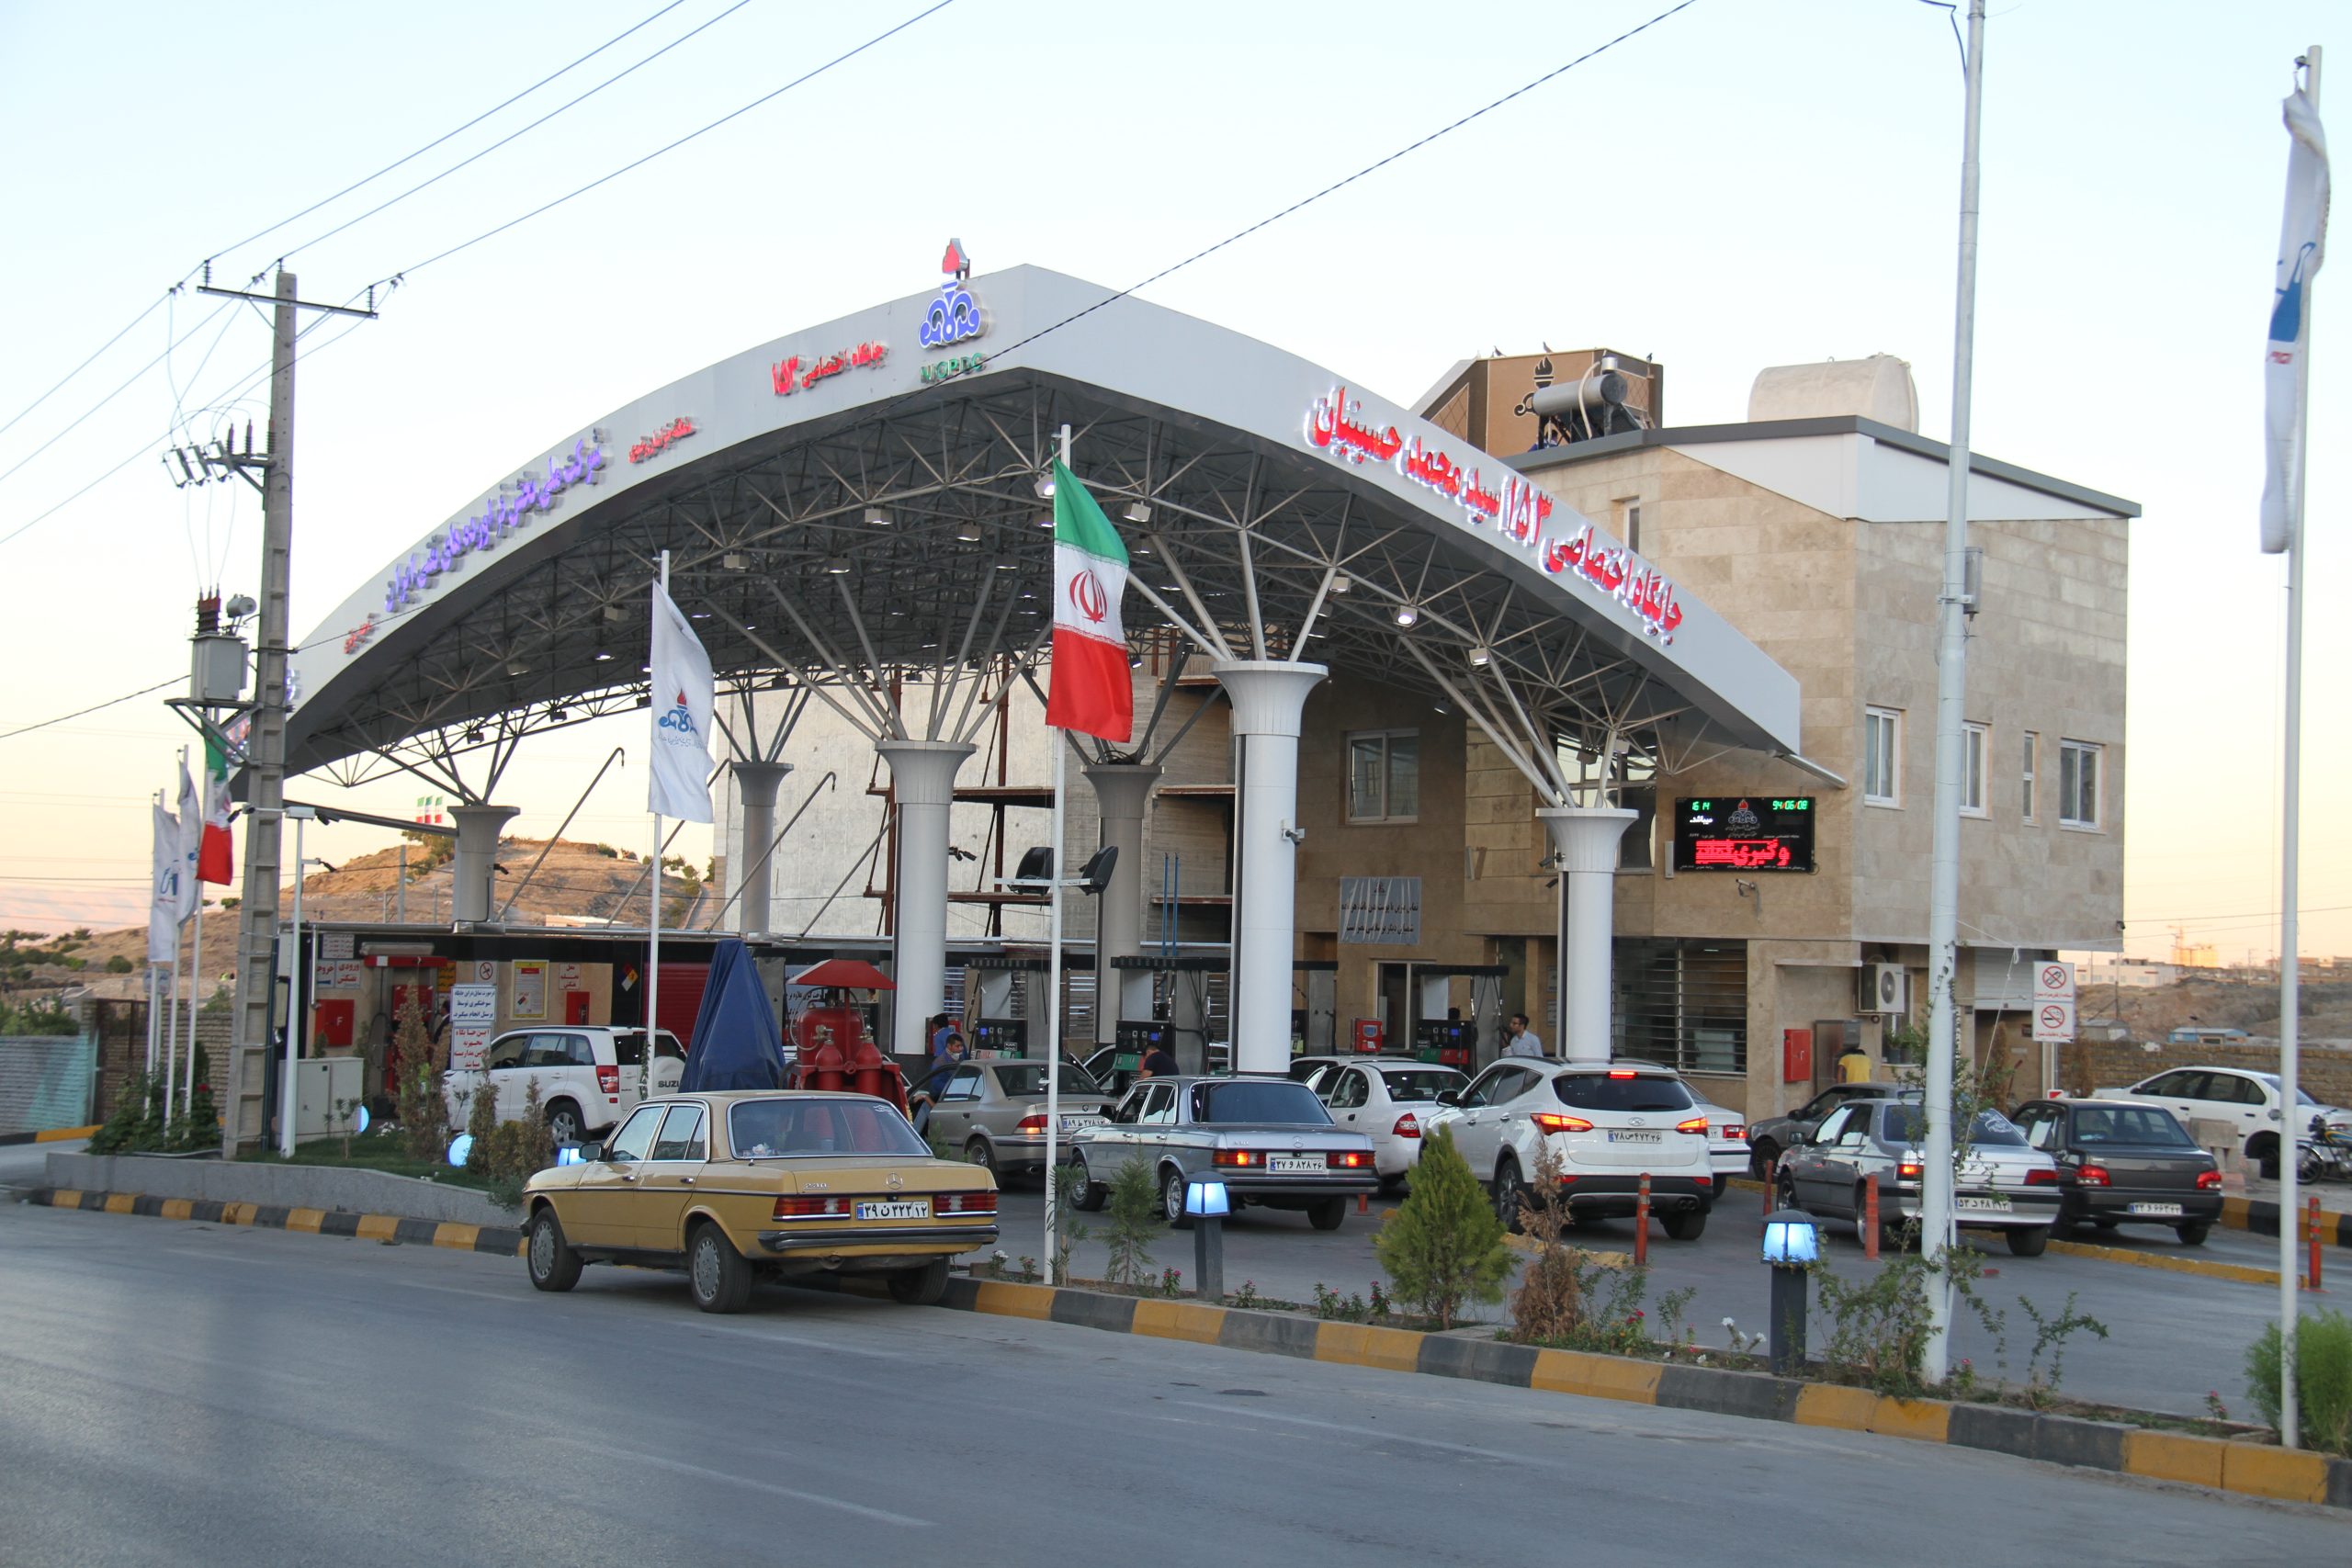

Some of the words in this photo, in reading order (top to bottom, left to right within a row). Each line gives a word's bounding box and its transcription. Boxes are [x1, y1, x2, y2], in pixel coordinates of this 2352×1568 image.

[772, 355, 799, 396] ۱۵۳
[801, 348, 849, 389] اختصاصی
[851, 340, 888, 369] جایگاه
[920, 353, 987, 384] NIOPDC
[1306, 385, 1402, 465] حسینیان
[537, 456, 563, 514] ملی
[563, 427, 604, 485] شرکت
[1399, 435, 1462, 498] محمد
[1462, 468, 1501, 525] سید
[1501, 476, 1554, 547] ۱۵۳
[385, 553, 416, 613] ایران
[1542, 525, 1634, 601] اختصاصی
[1633, 565, 1683, 647] جایگاه
